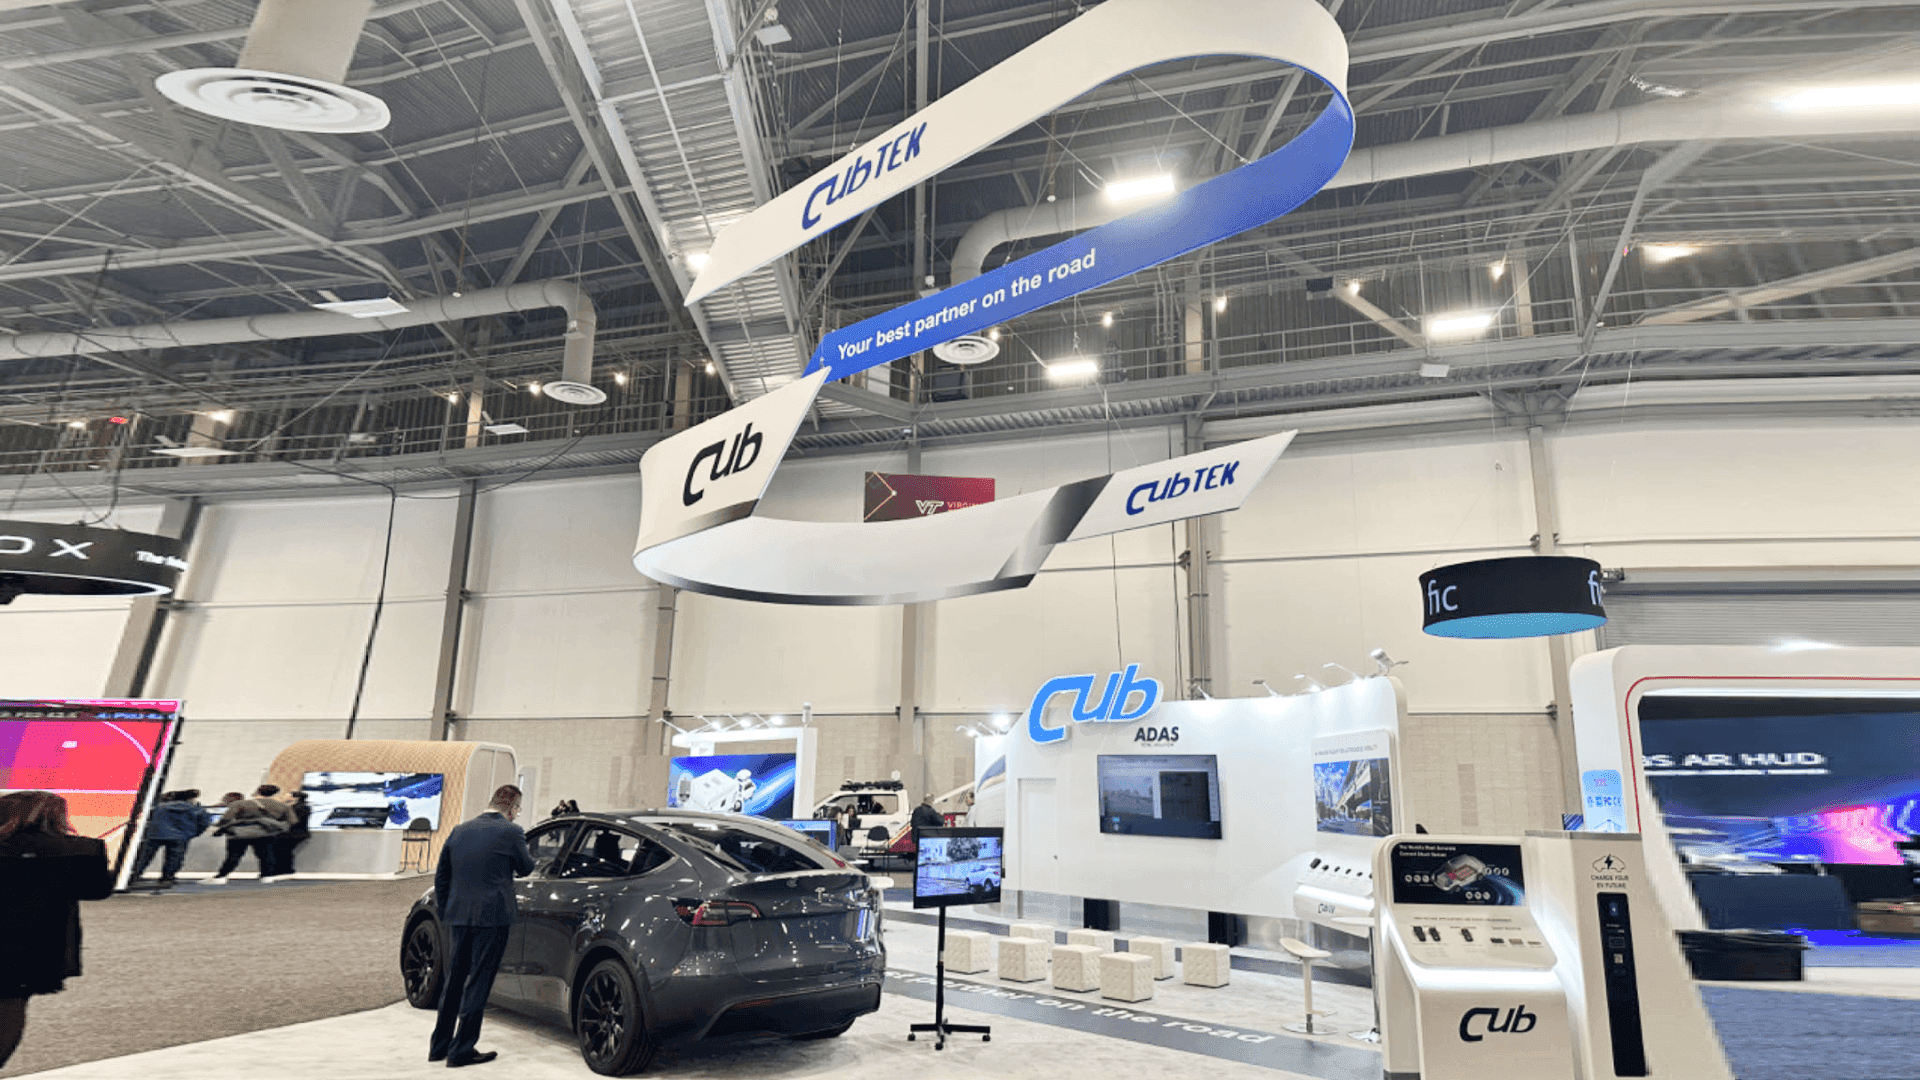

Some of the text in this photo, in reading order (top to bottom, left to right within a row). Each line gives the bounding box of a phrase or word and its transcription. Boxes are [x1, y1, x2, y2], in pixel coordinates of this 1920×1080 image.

[838, 248, 1096, 360] Your best partner on the road
[1427, 579, 1458, 616] fic
[1134, 726, 1179, 742] ADAS
[1682, 754, 1735, 766] AR
[1739, 752, 1827, 766] HUD
[1162, 1021, 1276, 1043] road
